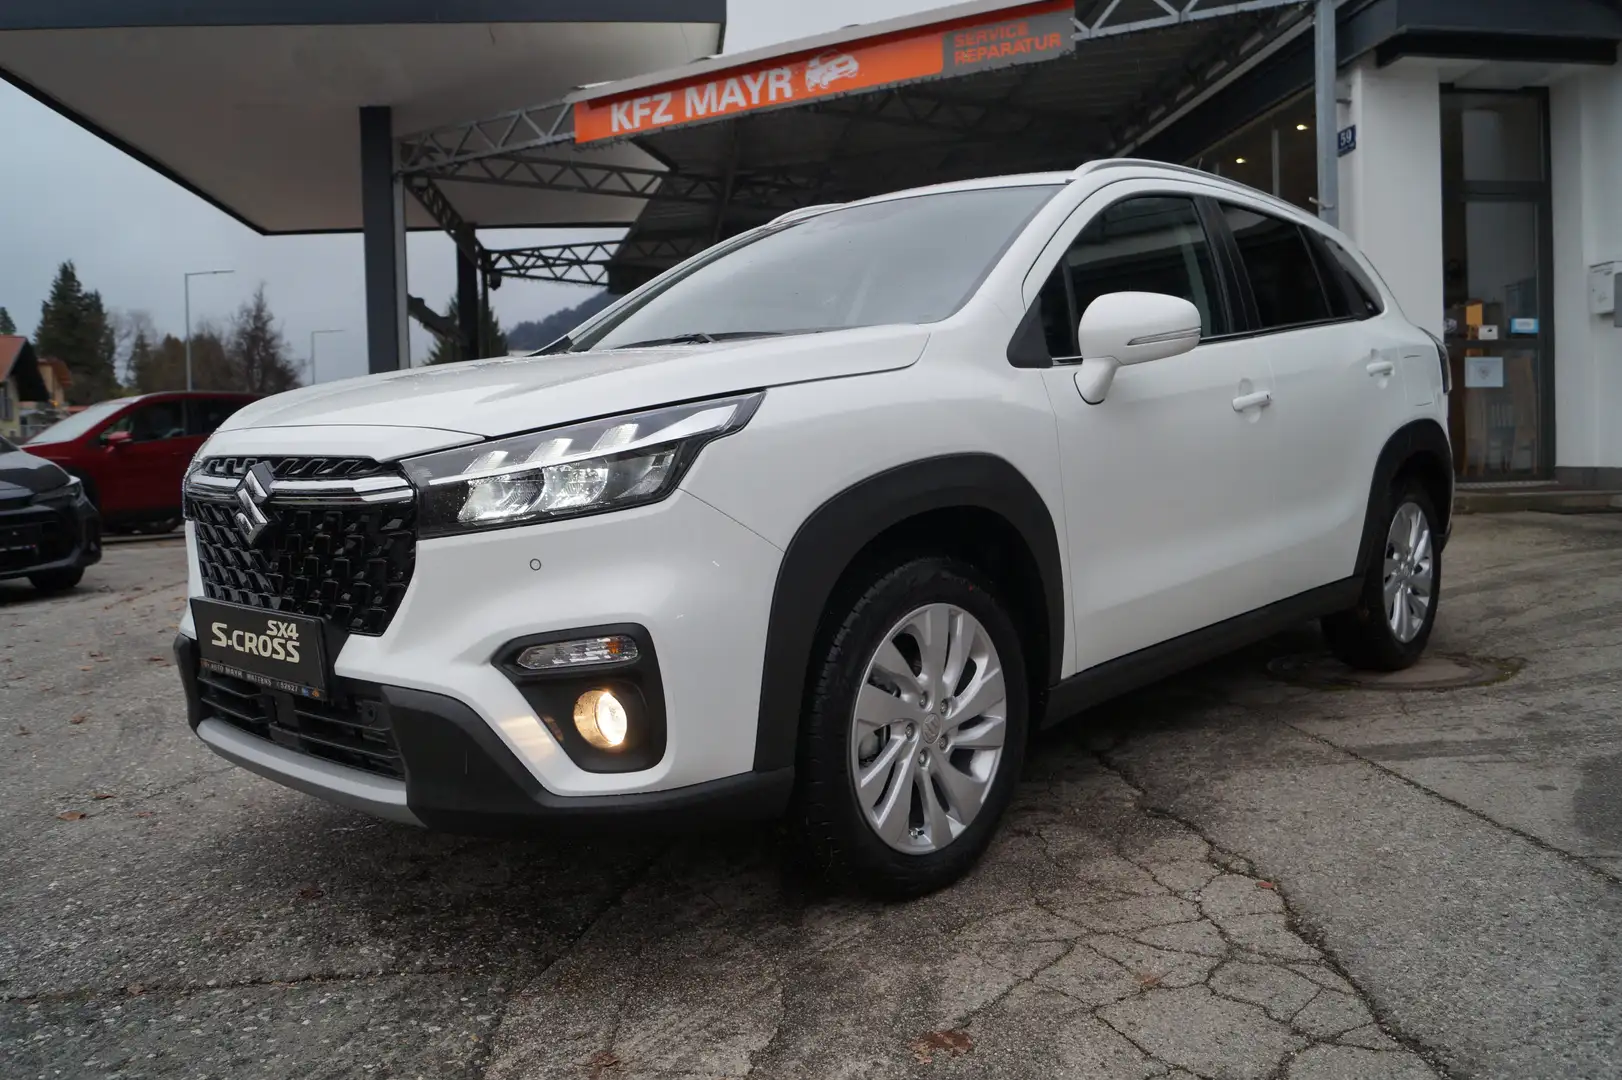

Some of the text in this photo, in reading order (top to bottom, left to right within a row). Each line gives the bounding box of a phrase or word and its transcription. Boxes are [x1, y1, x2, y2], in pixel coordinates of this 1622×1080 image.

[954, 22, 1029, 48] SERVICE
[954, 32, 1062, 66] REPARATUR
[611, 67, 793, 133] KFZ MAYR
[1340, 129, 1352, 146] 59
[266, 620, 299, 640] SX4
